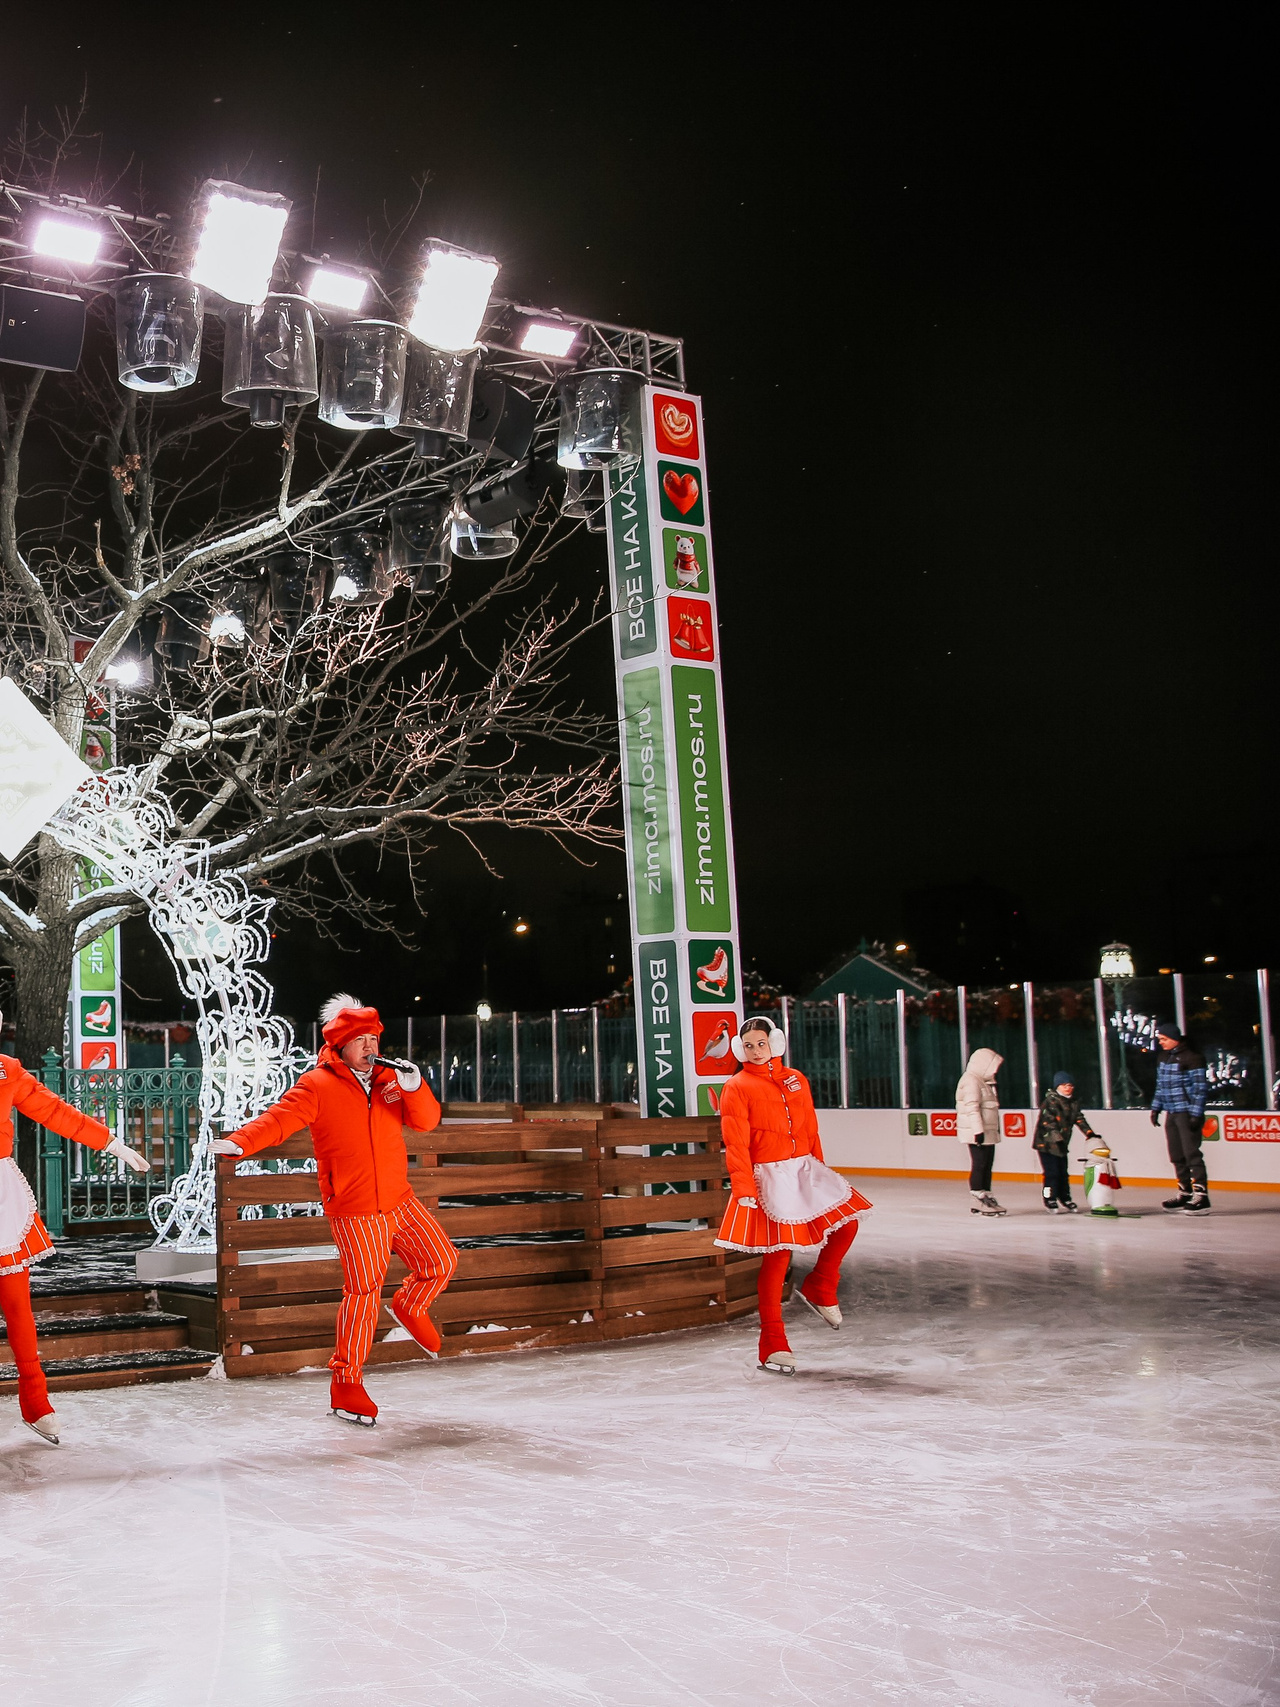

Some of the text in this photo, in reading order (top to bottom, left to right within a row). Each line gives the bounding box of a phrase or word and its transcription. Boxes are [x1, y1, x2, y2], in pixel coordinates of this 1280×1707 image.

[623, 522, 641, 571] НА
[626, 574, 646, 641] ВСЕ
[638, 706, 662, 895] zima.mos.ru
[688, 694, 715, 905] zima.mos.ru
[649, 959, 669, 1025] ВСЕ
[654, 1033, 673, 1081] НА
[934, 1118, 957, 1131] 20
[1226, 1117, 1280, 1131] ЗИМА
[1226, 1132, 1280, 1140] В МОСКВЕ
